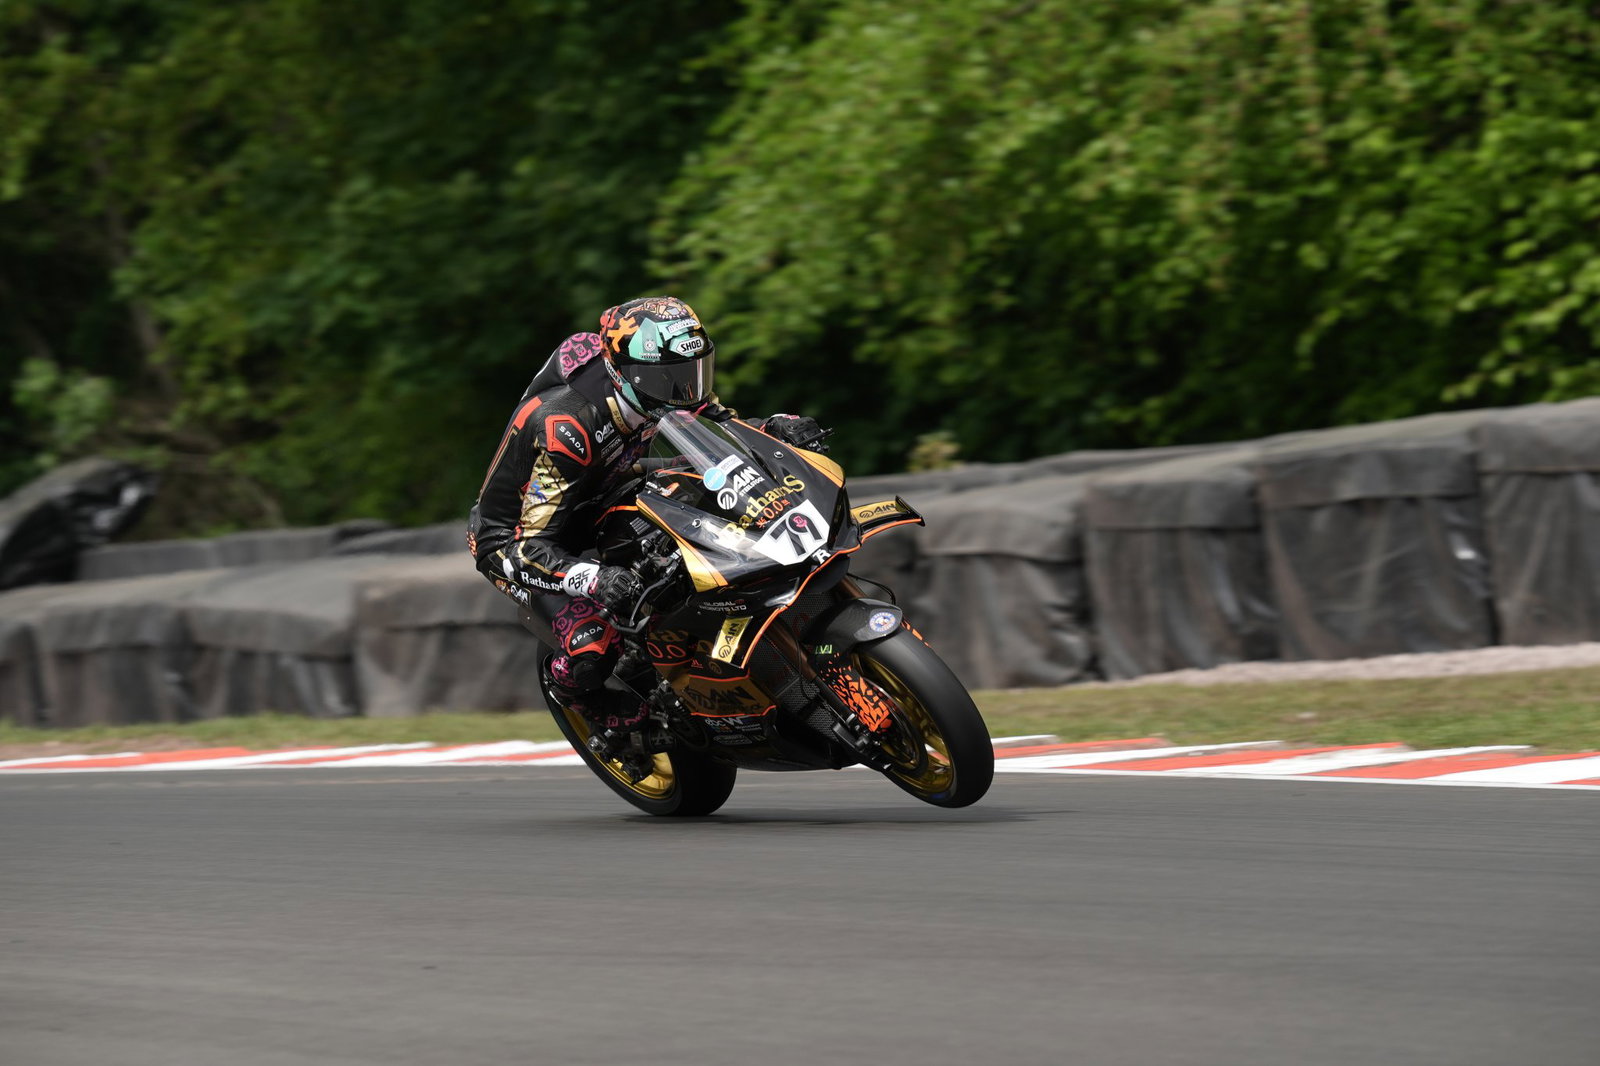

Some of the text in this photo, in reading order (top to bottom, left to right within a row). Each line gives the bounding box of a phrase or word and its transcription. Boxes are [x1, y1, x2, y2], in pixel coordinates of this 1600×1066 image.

[680, 339, 702, 353] SHOEI
[558, 425, 585, 455] SPADA
[769, 511, 823, 557] 79
[730, 604, 747, 612] LTD
[571, 625, 604, 646] SPADA
